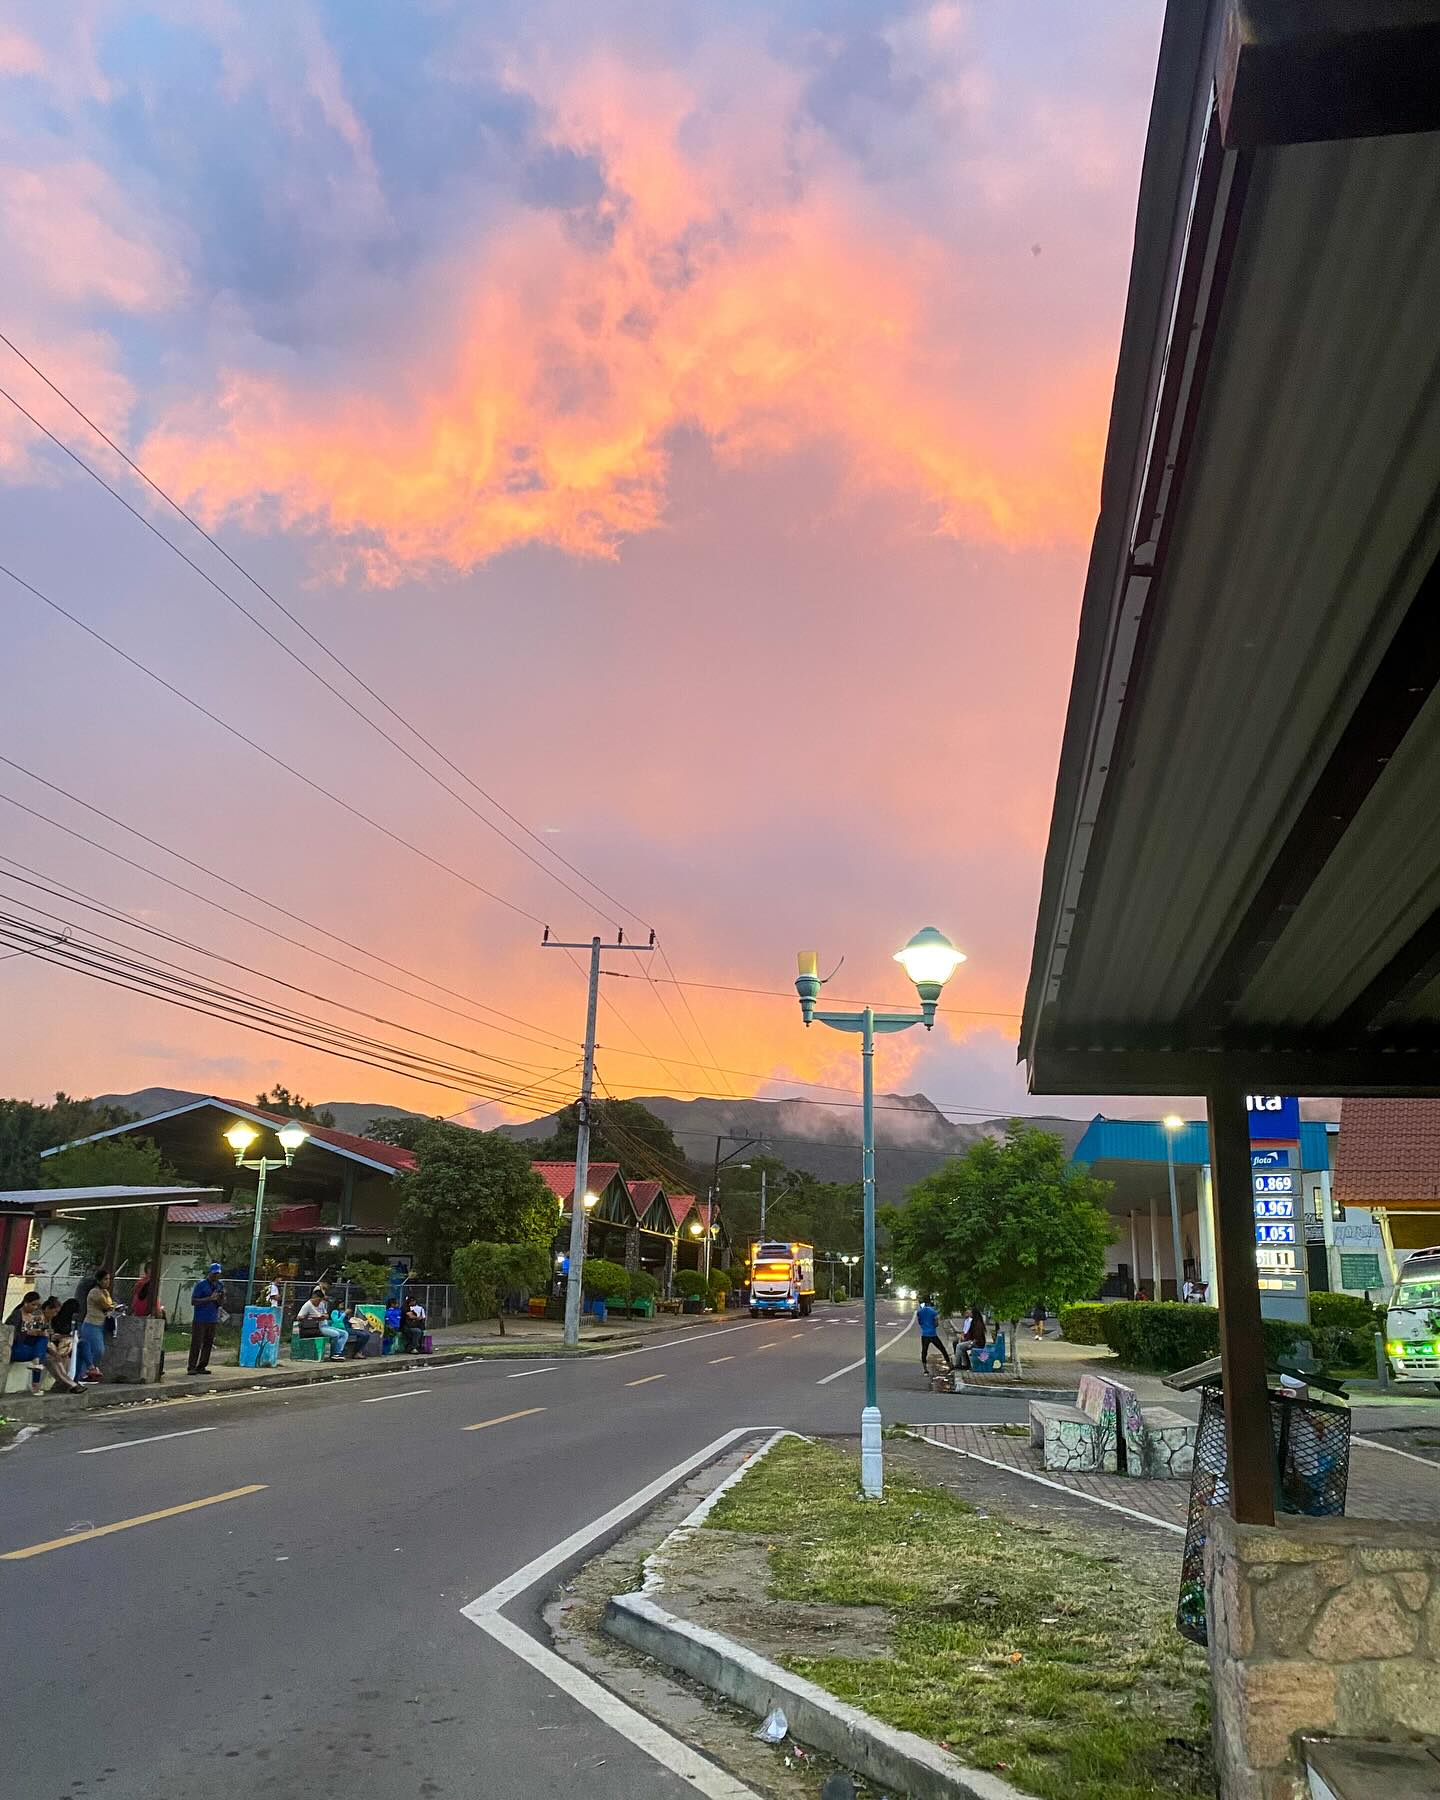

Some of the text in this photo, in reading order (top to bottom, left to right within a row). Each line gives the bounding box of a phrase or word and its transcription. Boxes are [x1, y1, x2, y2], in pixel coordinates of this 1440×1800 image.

[1246, 1095, 1282, 1111] lta
[1255, 1177, 1292, 1191] 0.869
[1256, 1201, 1293, 1216] 0.967
[1258, 1226, 1294, 1241] 1.051
